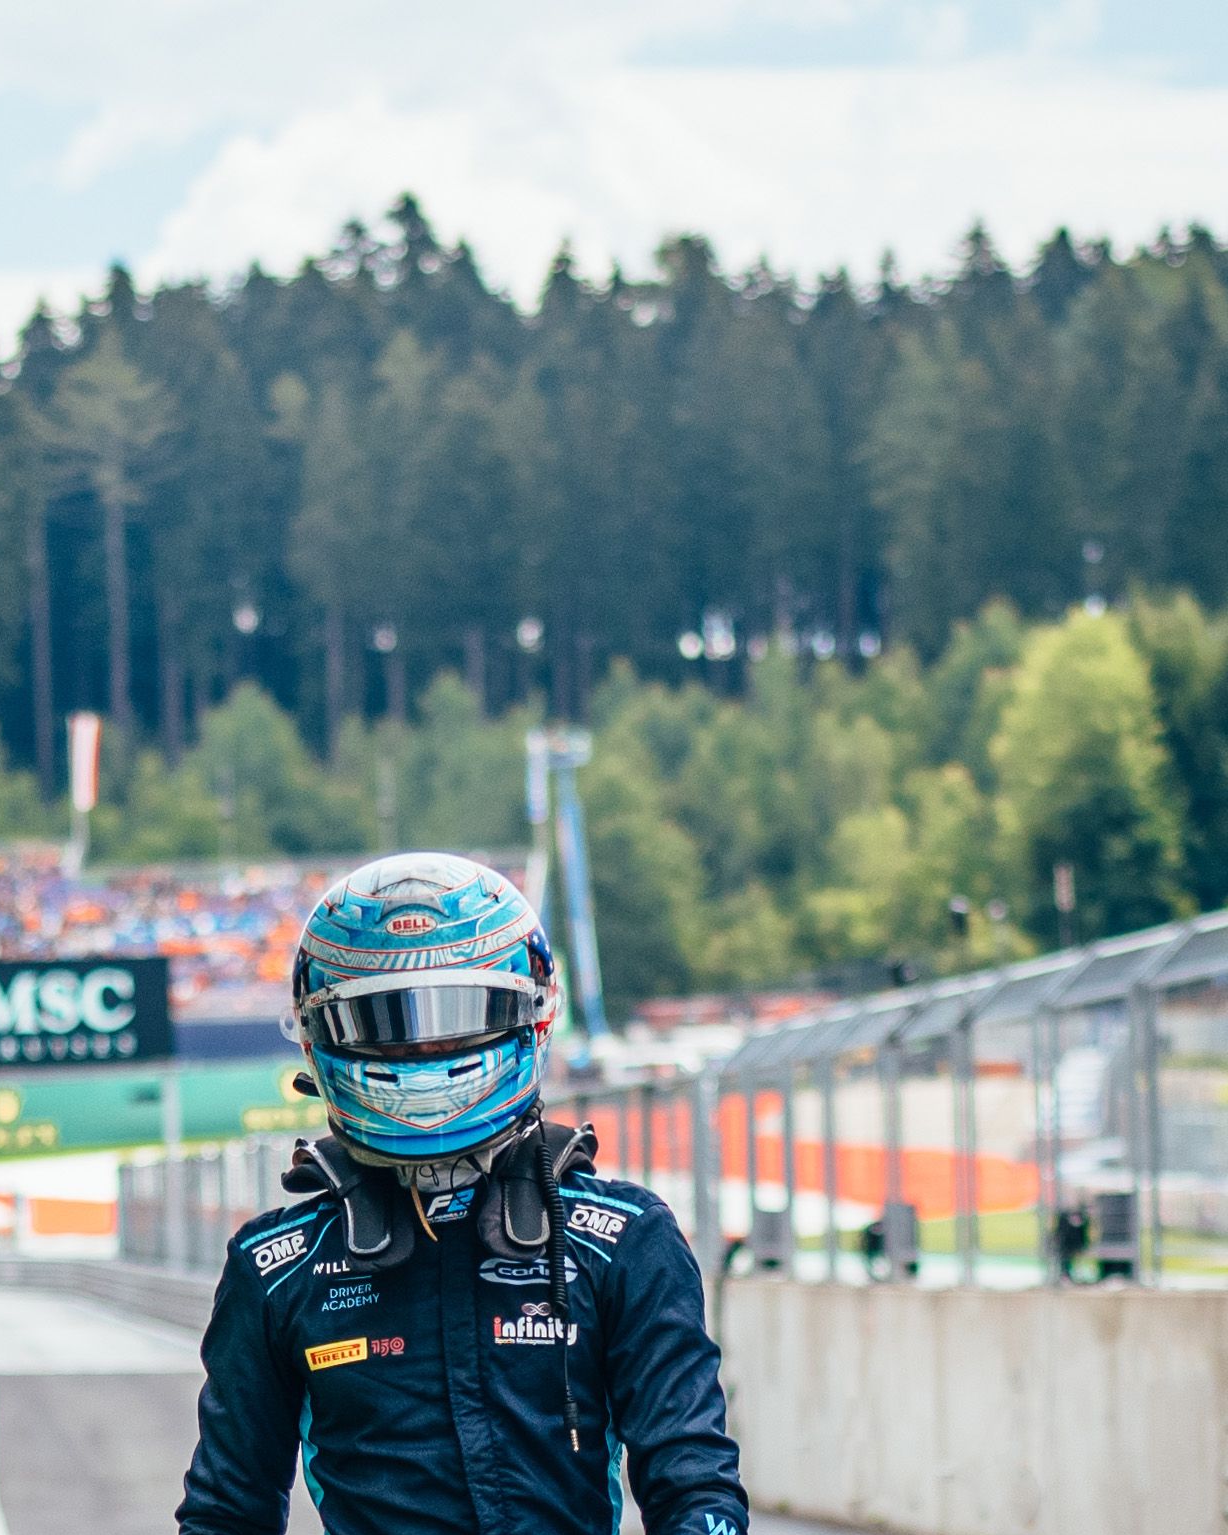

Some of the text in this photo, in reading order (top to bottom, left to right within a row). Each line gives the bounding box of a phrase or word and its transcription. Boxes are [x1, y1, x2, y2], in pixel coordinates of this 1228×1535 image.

[393, 918, 430, 930] BELL
[426, 1188, 475, 1217] F2
[571, 1209, 623, 1236] OMP
[255, 1234, 305, 1270] OMP
[312, 1259, 351, 1276] WILL
[498, 1264, 551, 1277] carli
[329, 1283, 372, 1299] DRIVER
[321, 1293, 380, 1312] ACADEMY
[310, 1343, 361, 1365] PIRELLI
